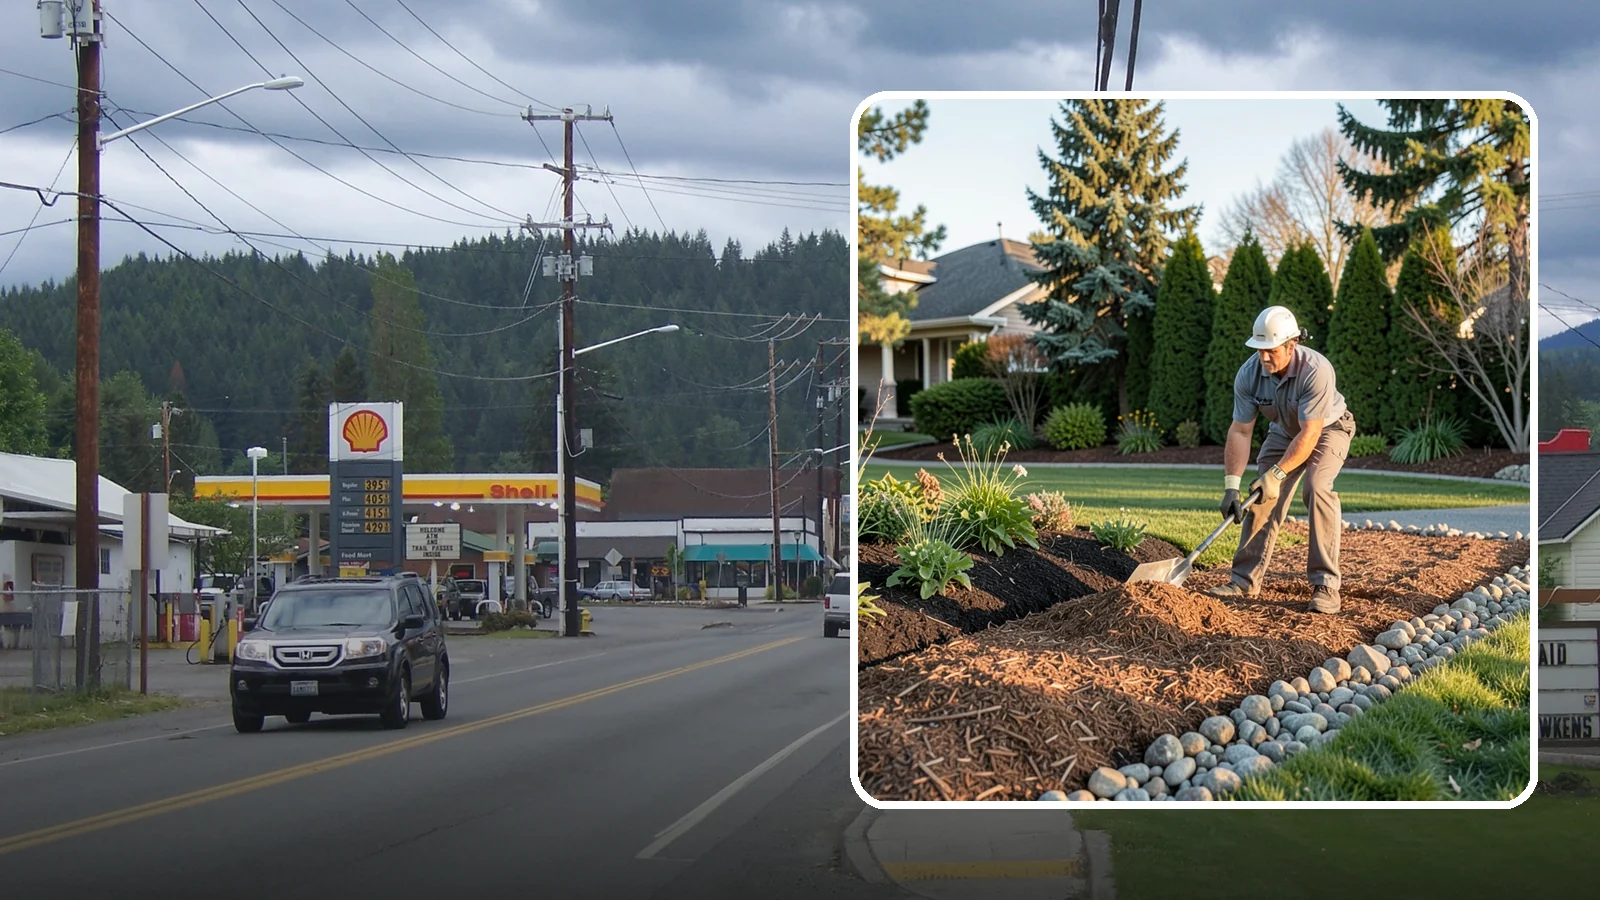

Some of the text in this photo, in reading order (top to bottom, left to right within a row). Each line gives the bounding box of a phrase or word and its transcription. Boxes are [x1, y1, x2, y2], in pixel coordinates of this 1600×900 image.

[366, 480, 383, 490] 395
[490, 484, 547, 499] Shell
[365, 494, 383, 504] 405
[365, 508, 383, 518] 415
[365, 523, 383, 533] 429
